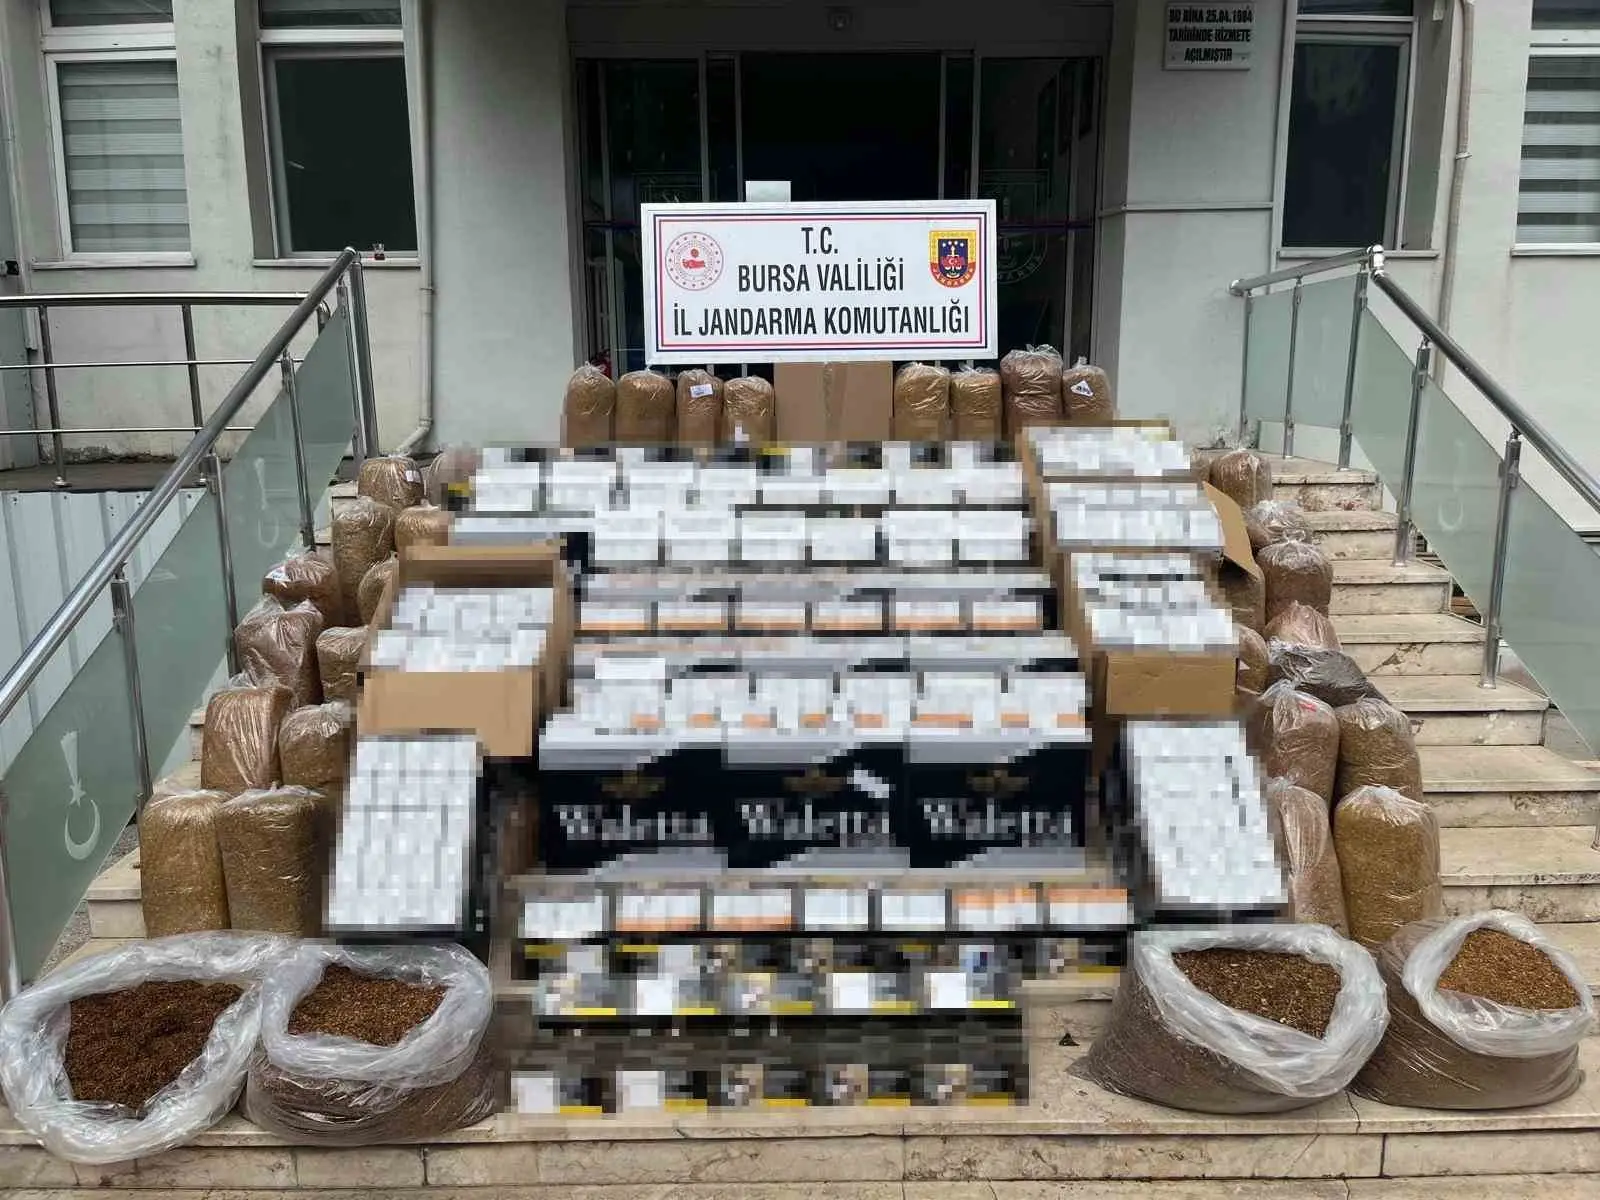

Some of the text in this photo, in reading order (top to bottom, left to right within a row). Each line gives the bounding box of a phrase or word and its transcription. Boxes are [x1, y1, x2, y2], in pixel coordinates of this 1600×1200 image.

[801, 227, 839, 254] T.C.
[738, 257, 904, 292] BURSA VALİLİĞİ
[674, 298, 969, 336] İL JANDARMA KOMUTANLIĞI
